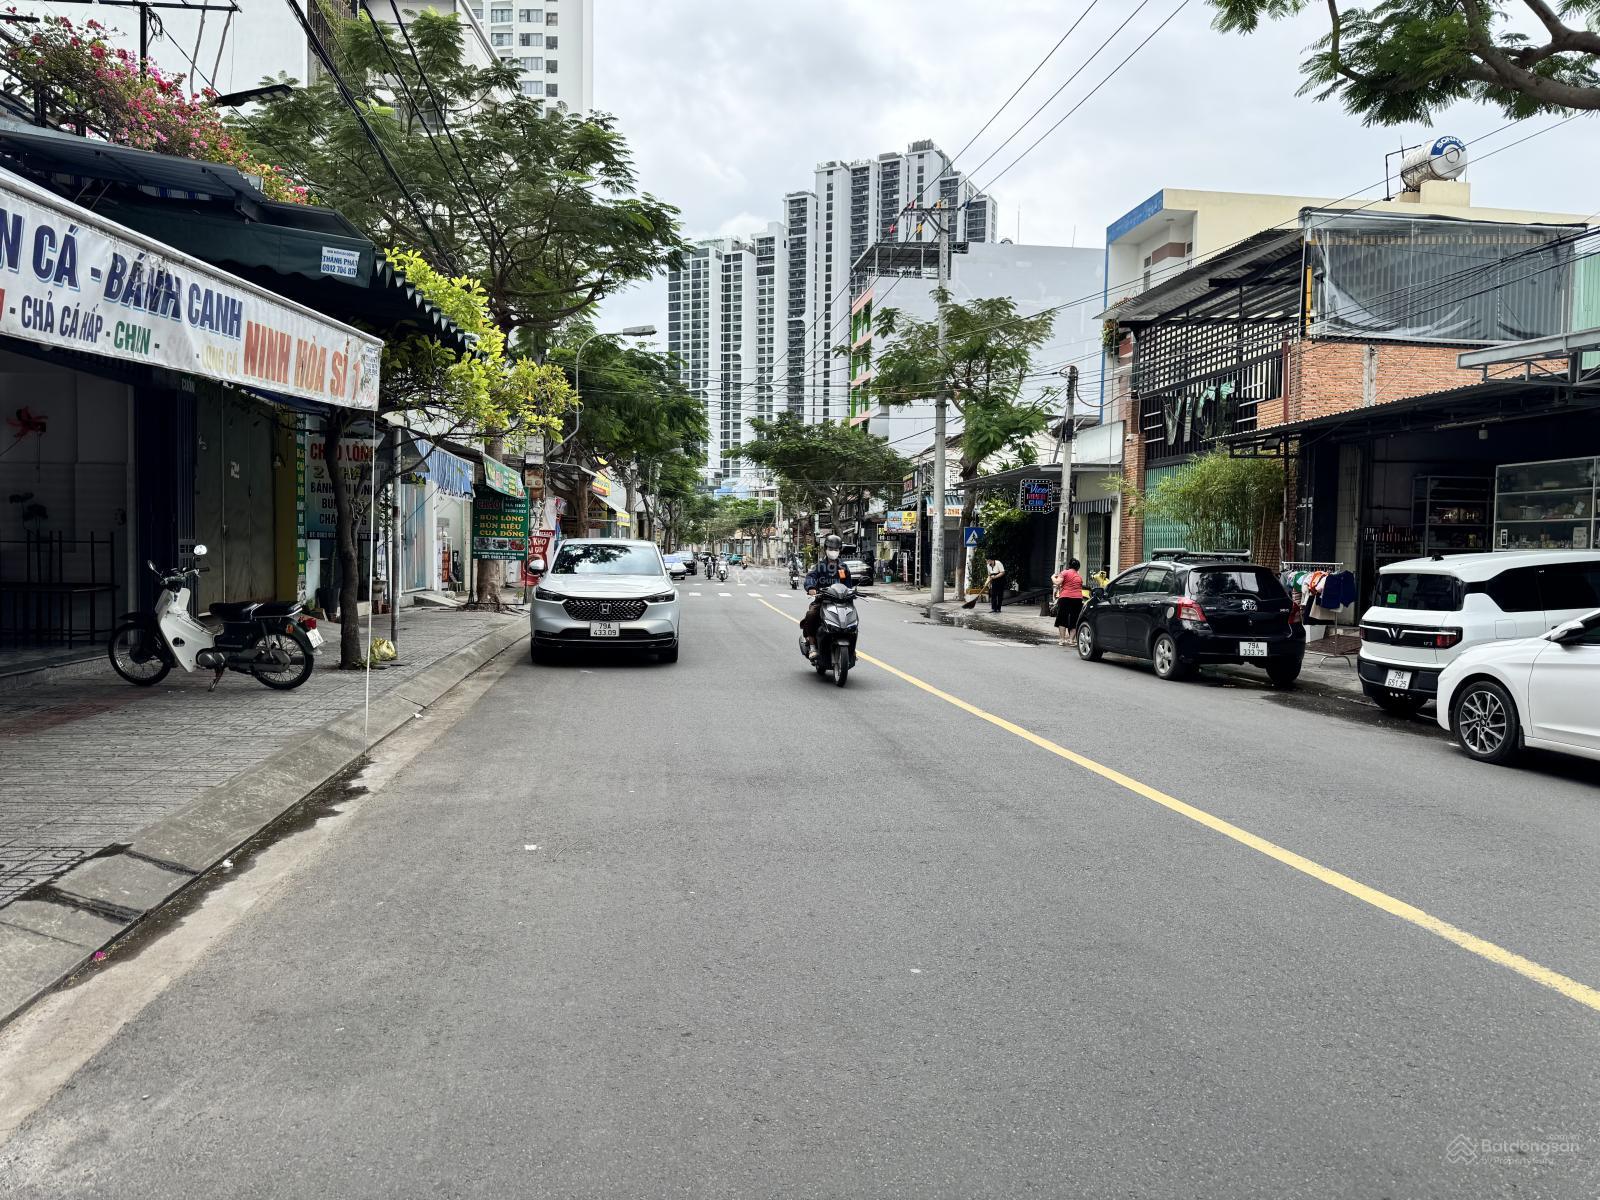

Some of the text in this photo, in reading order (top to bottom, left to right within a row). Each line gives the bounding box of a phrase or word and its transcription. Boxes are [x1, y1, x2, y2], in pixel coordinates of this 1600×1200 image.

[33, 223, 80, 292] CÁ
[103, 252, 183, 322] BÁNH
[187, 282, 243, 341] CANH
[21, 291, 54, 333] CHẢ
[59, 302, 80, 339] CÁ
[79, 303, 103, 343] HẤP
[243, 320, 292, 385] NINH
[310, 442, 343, 460] CHO
[501, 513, 524, 522] LÒNG
[1243, 648, 1265, 656] 333.75
